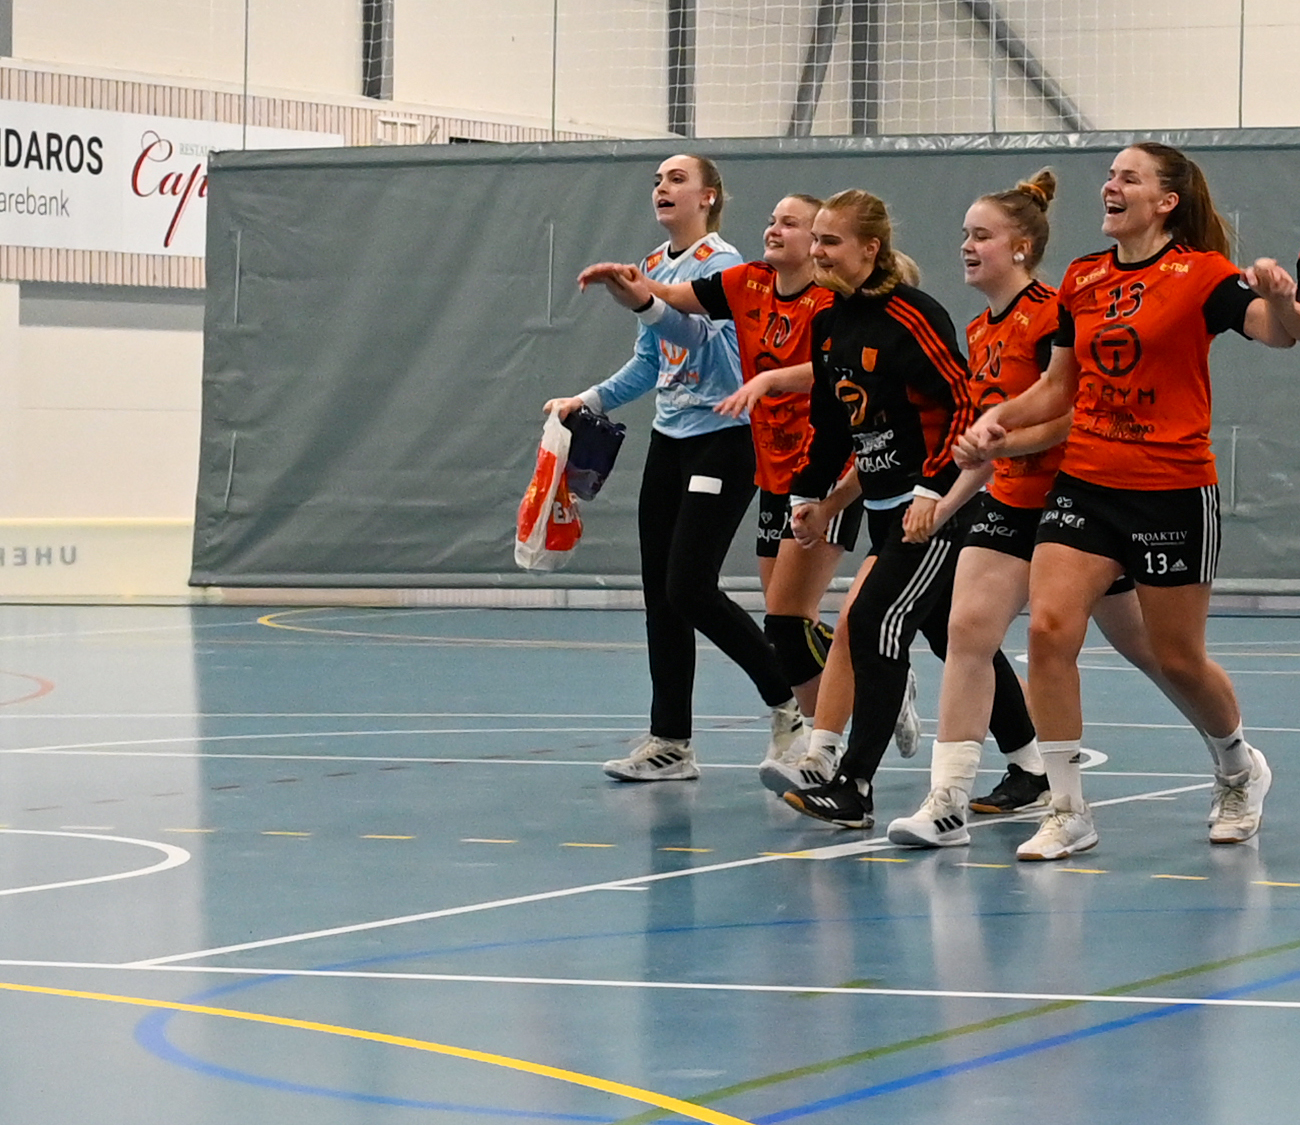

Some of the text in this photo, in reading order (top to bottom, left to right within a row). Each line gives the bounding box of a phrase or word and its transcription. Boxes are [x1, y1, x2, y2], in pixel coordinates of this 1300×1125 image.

[0, 128, 103, 175] DAROS
[1104, 281, 1146, 319] 13
[1131, 530, 1188, 546] PROAKTIV
[1144, 551, 1168, 575] 13
